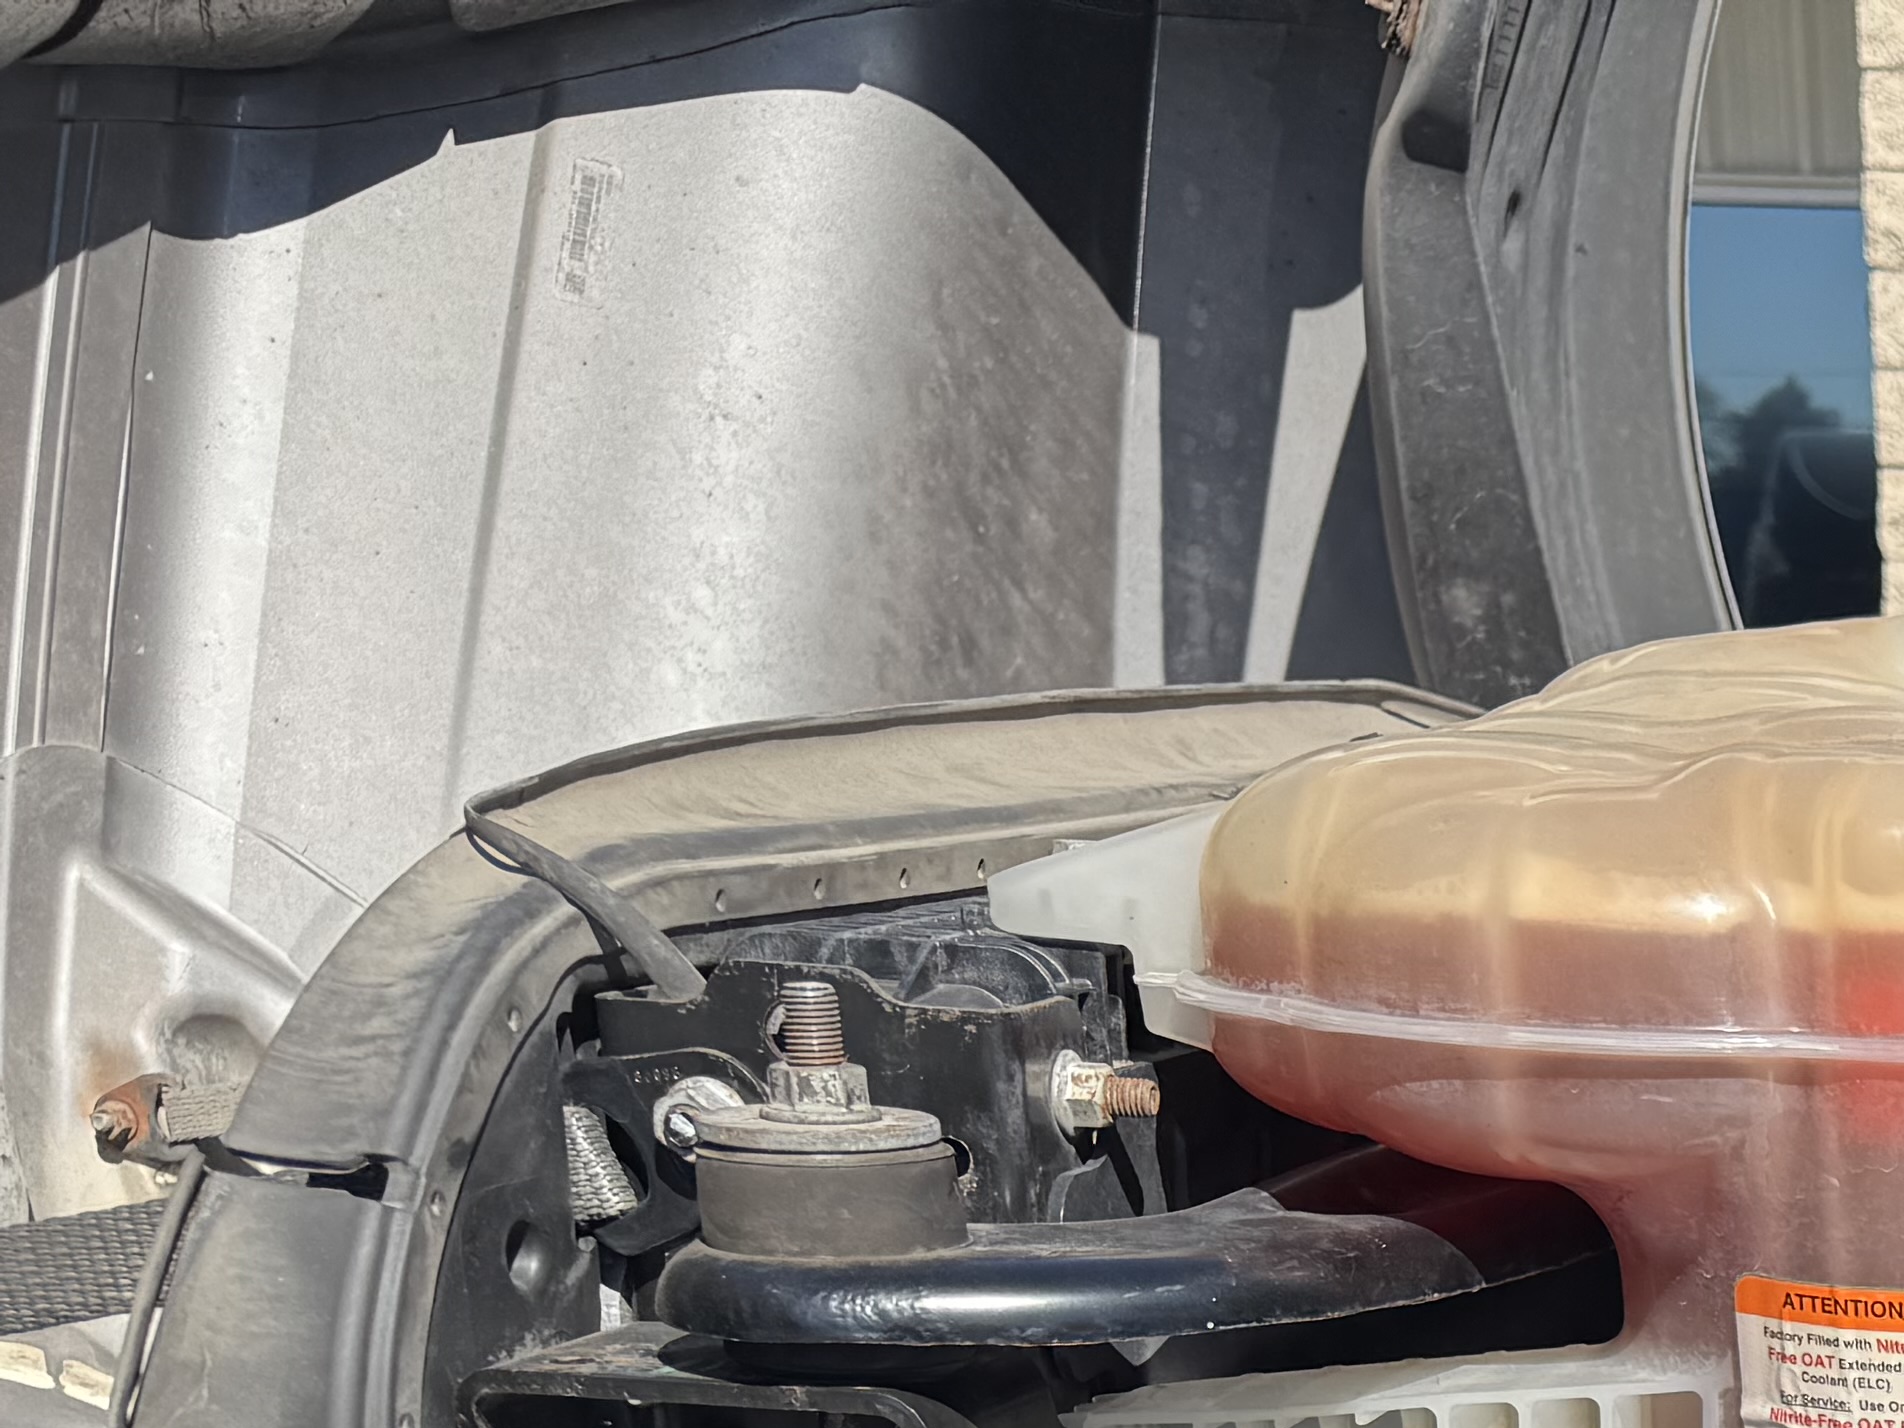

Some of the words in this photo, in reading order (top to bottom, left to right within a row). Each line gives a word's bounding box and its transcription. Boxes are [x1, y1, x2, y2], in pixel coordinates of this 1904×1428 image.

[1783, 1292, 1904, 1320] ATTENTION
[1763, 1326, 1804, 1346] Factory
[1807, 1334, 1840, 1348] Filled
[1843, 1338, 1872, 1352] with
[1768, 1347, 1797, 1364] Free
[1801, 1352, 1835, 1369] OAT
[1838, 1358, 1902, 1373] Extended
[1801, 1372, 1848, 1388] Coolant
[1853, 1377, 1891, 1393] (ELC)
[1781, 1391, 1799, 1406] For
[1801, 1394, 1851, 1411] Service:
[1859, 1400, 1885, 1412] Use
